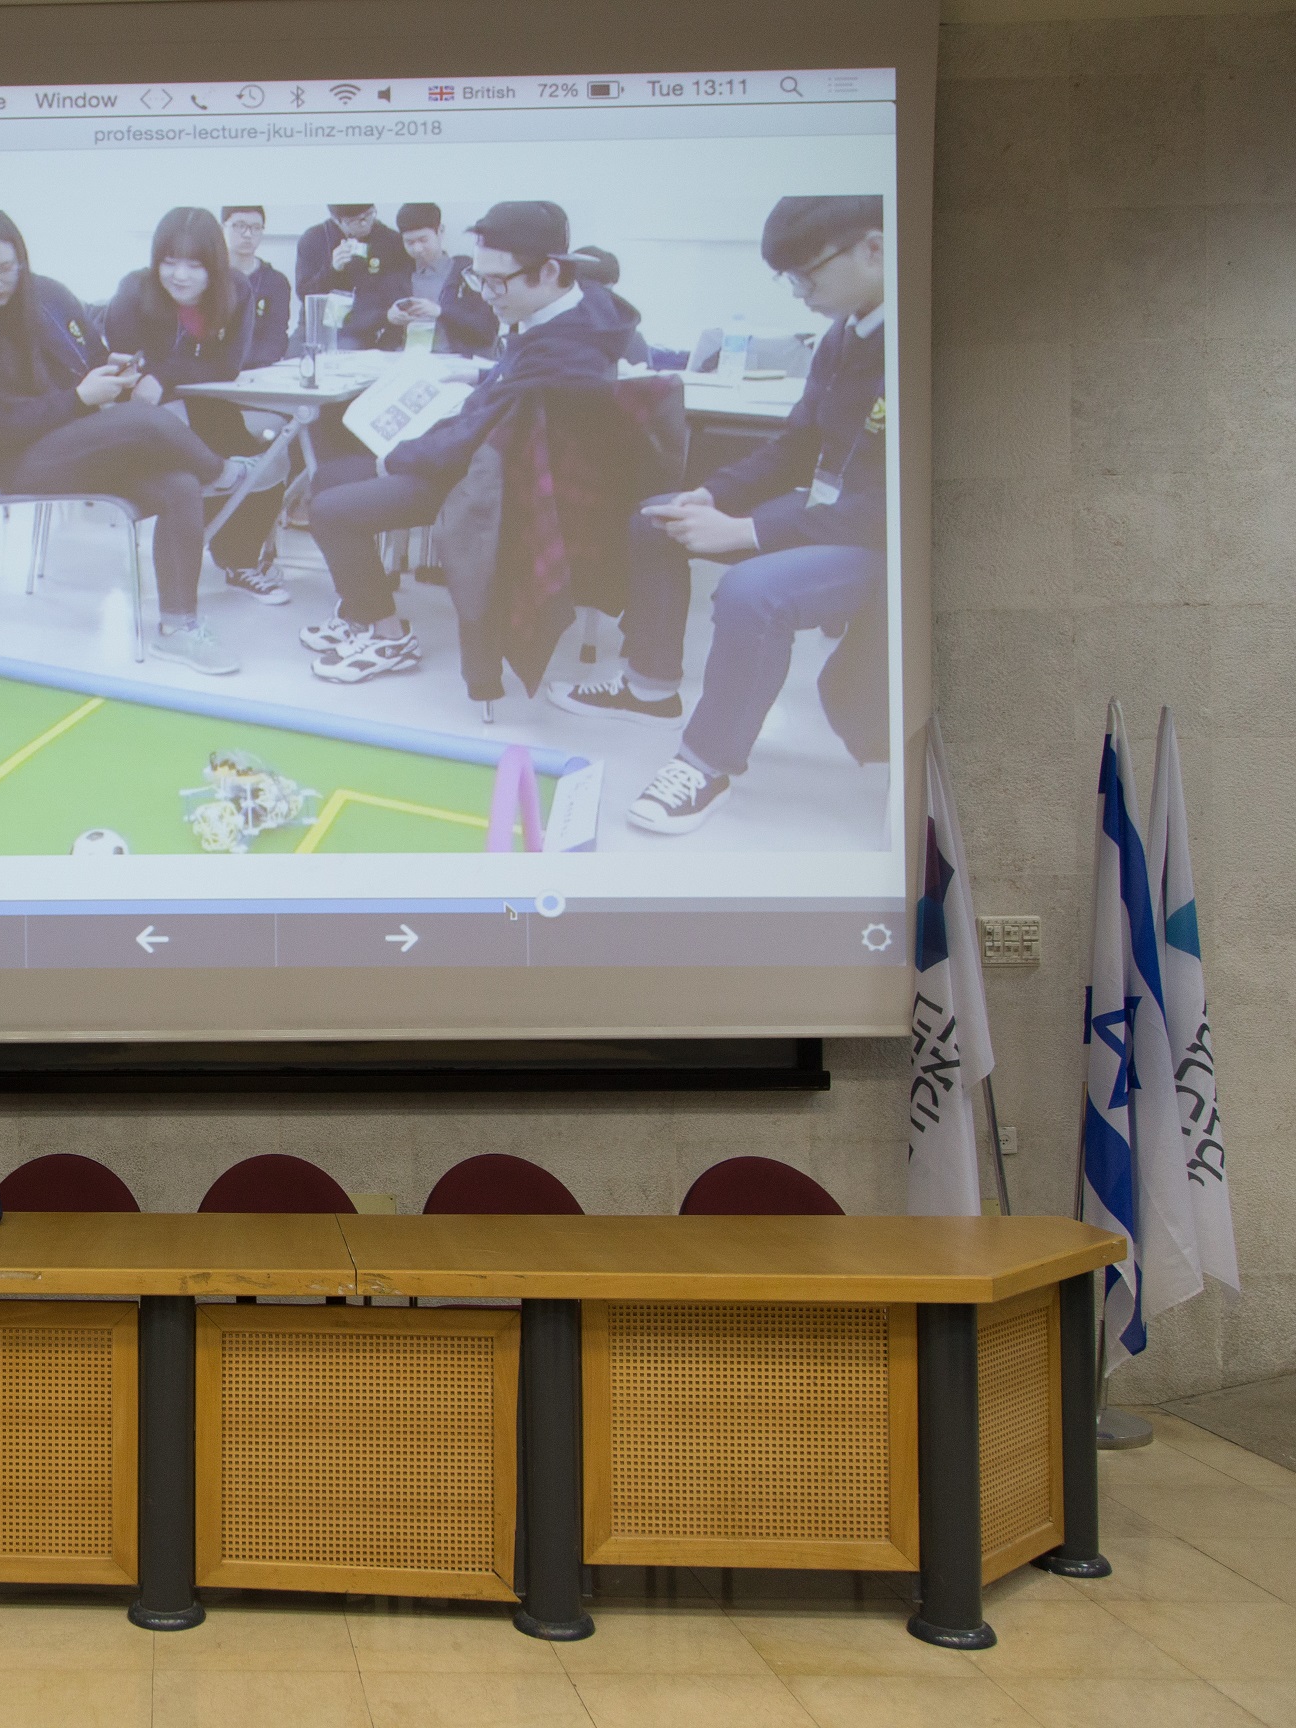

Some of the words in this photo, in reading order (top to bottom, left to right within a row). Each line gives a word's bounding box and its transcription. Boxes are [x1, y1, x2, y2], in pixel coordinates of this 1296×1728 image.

[462, 85, 516, 100] British
[537, 83, 579, 98] 72%
[647, 80, 684, 97] Tue
[693, 78, 748, 96] 13:11
[35, 92, 118, 109] Window
[94, 120, 443, 145] professor-lecture-jku-linz-may-2018
